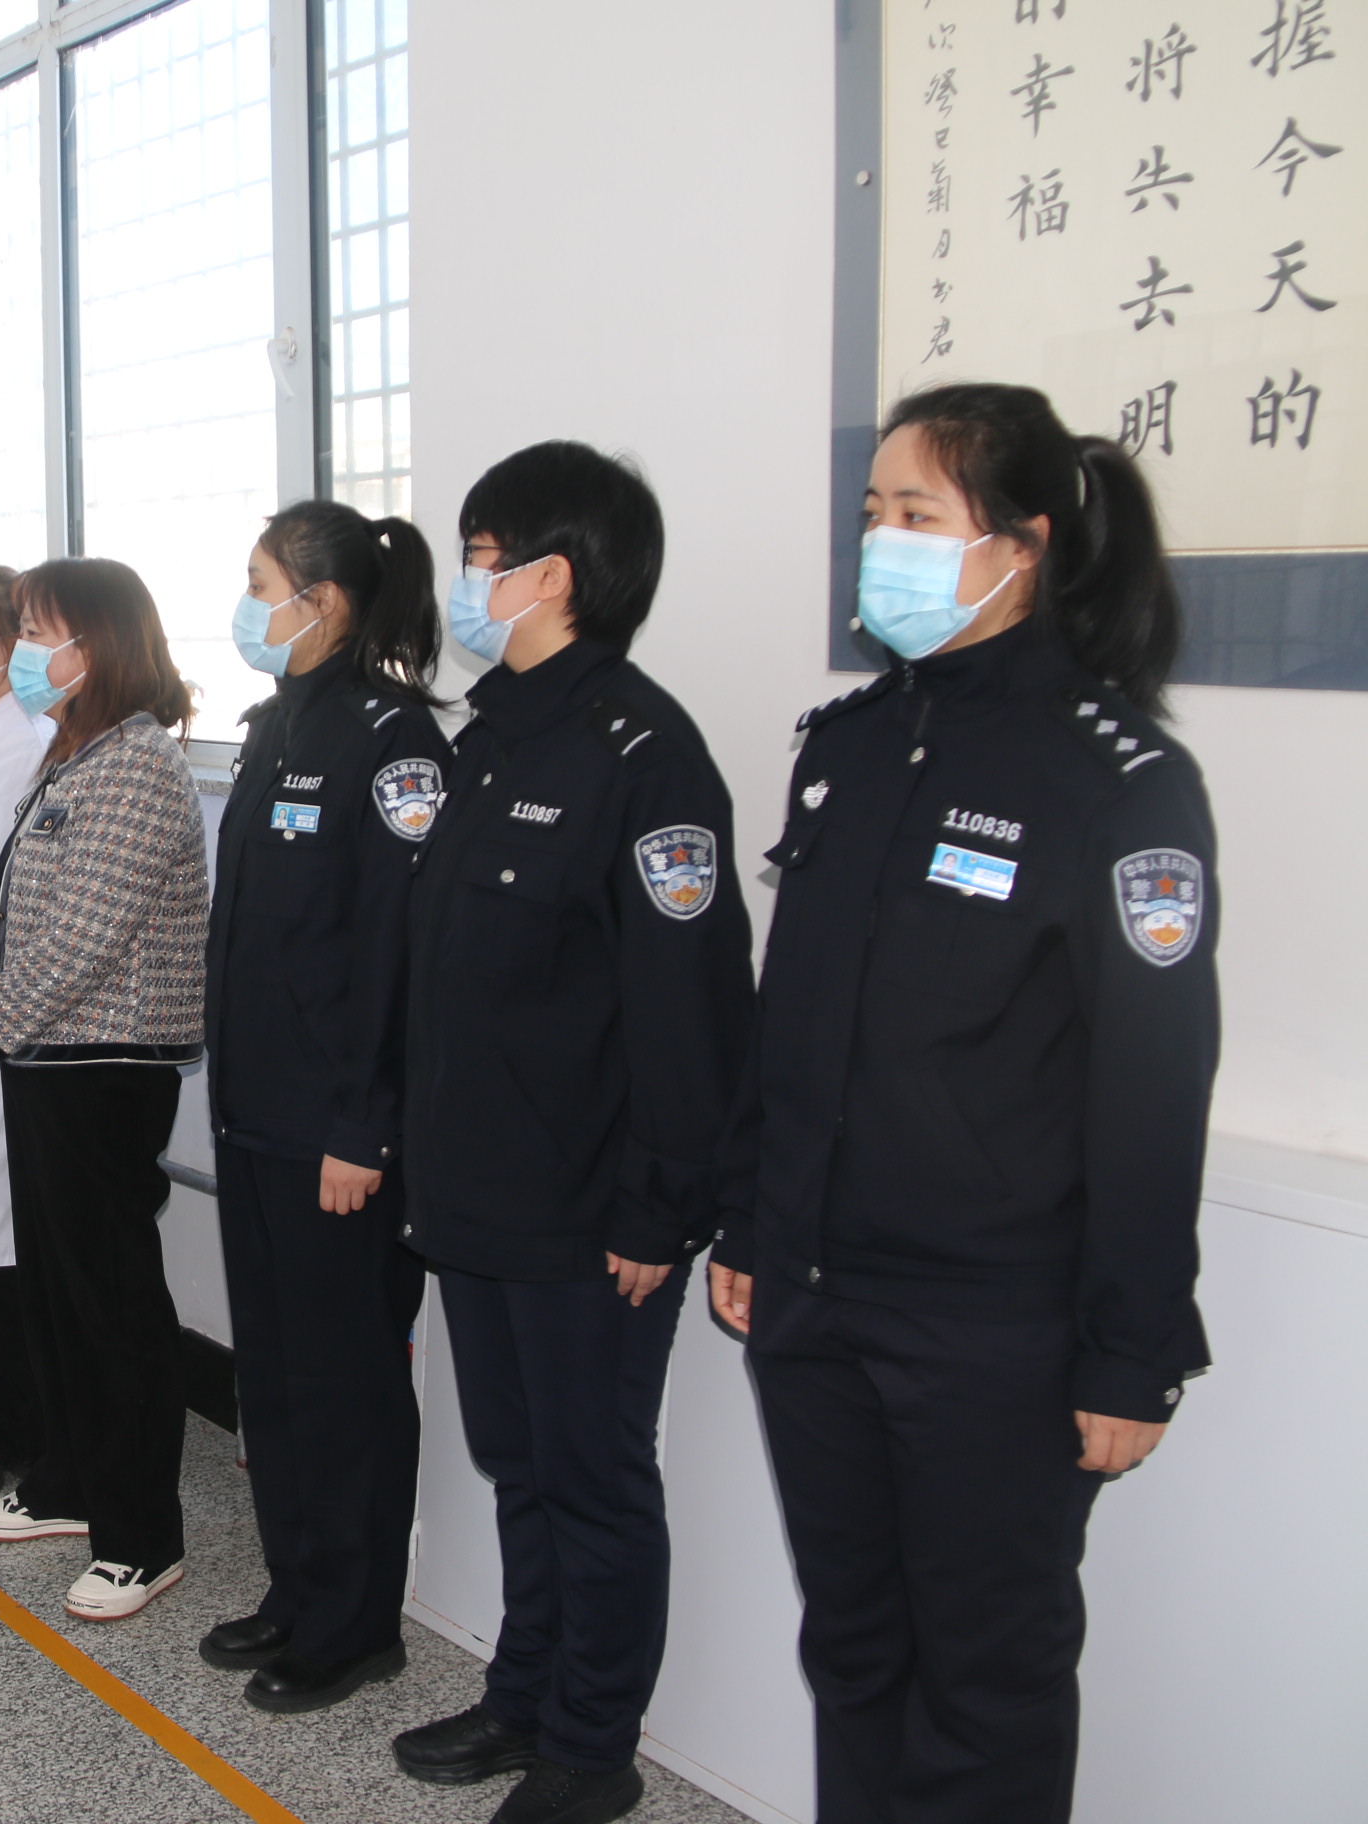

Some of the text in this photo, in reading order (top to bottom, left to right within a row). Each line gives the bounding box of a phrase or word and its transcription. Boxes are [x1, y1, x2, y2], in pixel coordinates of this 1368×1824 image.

[1246, 0, 1343, 450] 握今天的
[510, 800, 563, 823] 110897
[943, 808, 1022, 841] 110836
